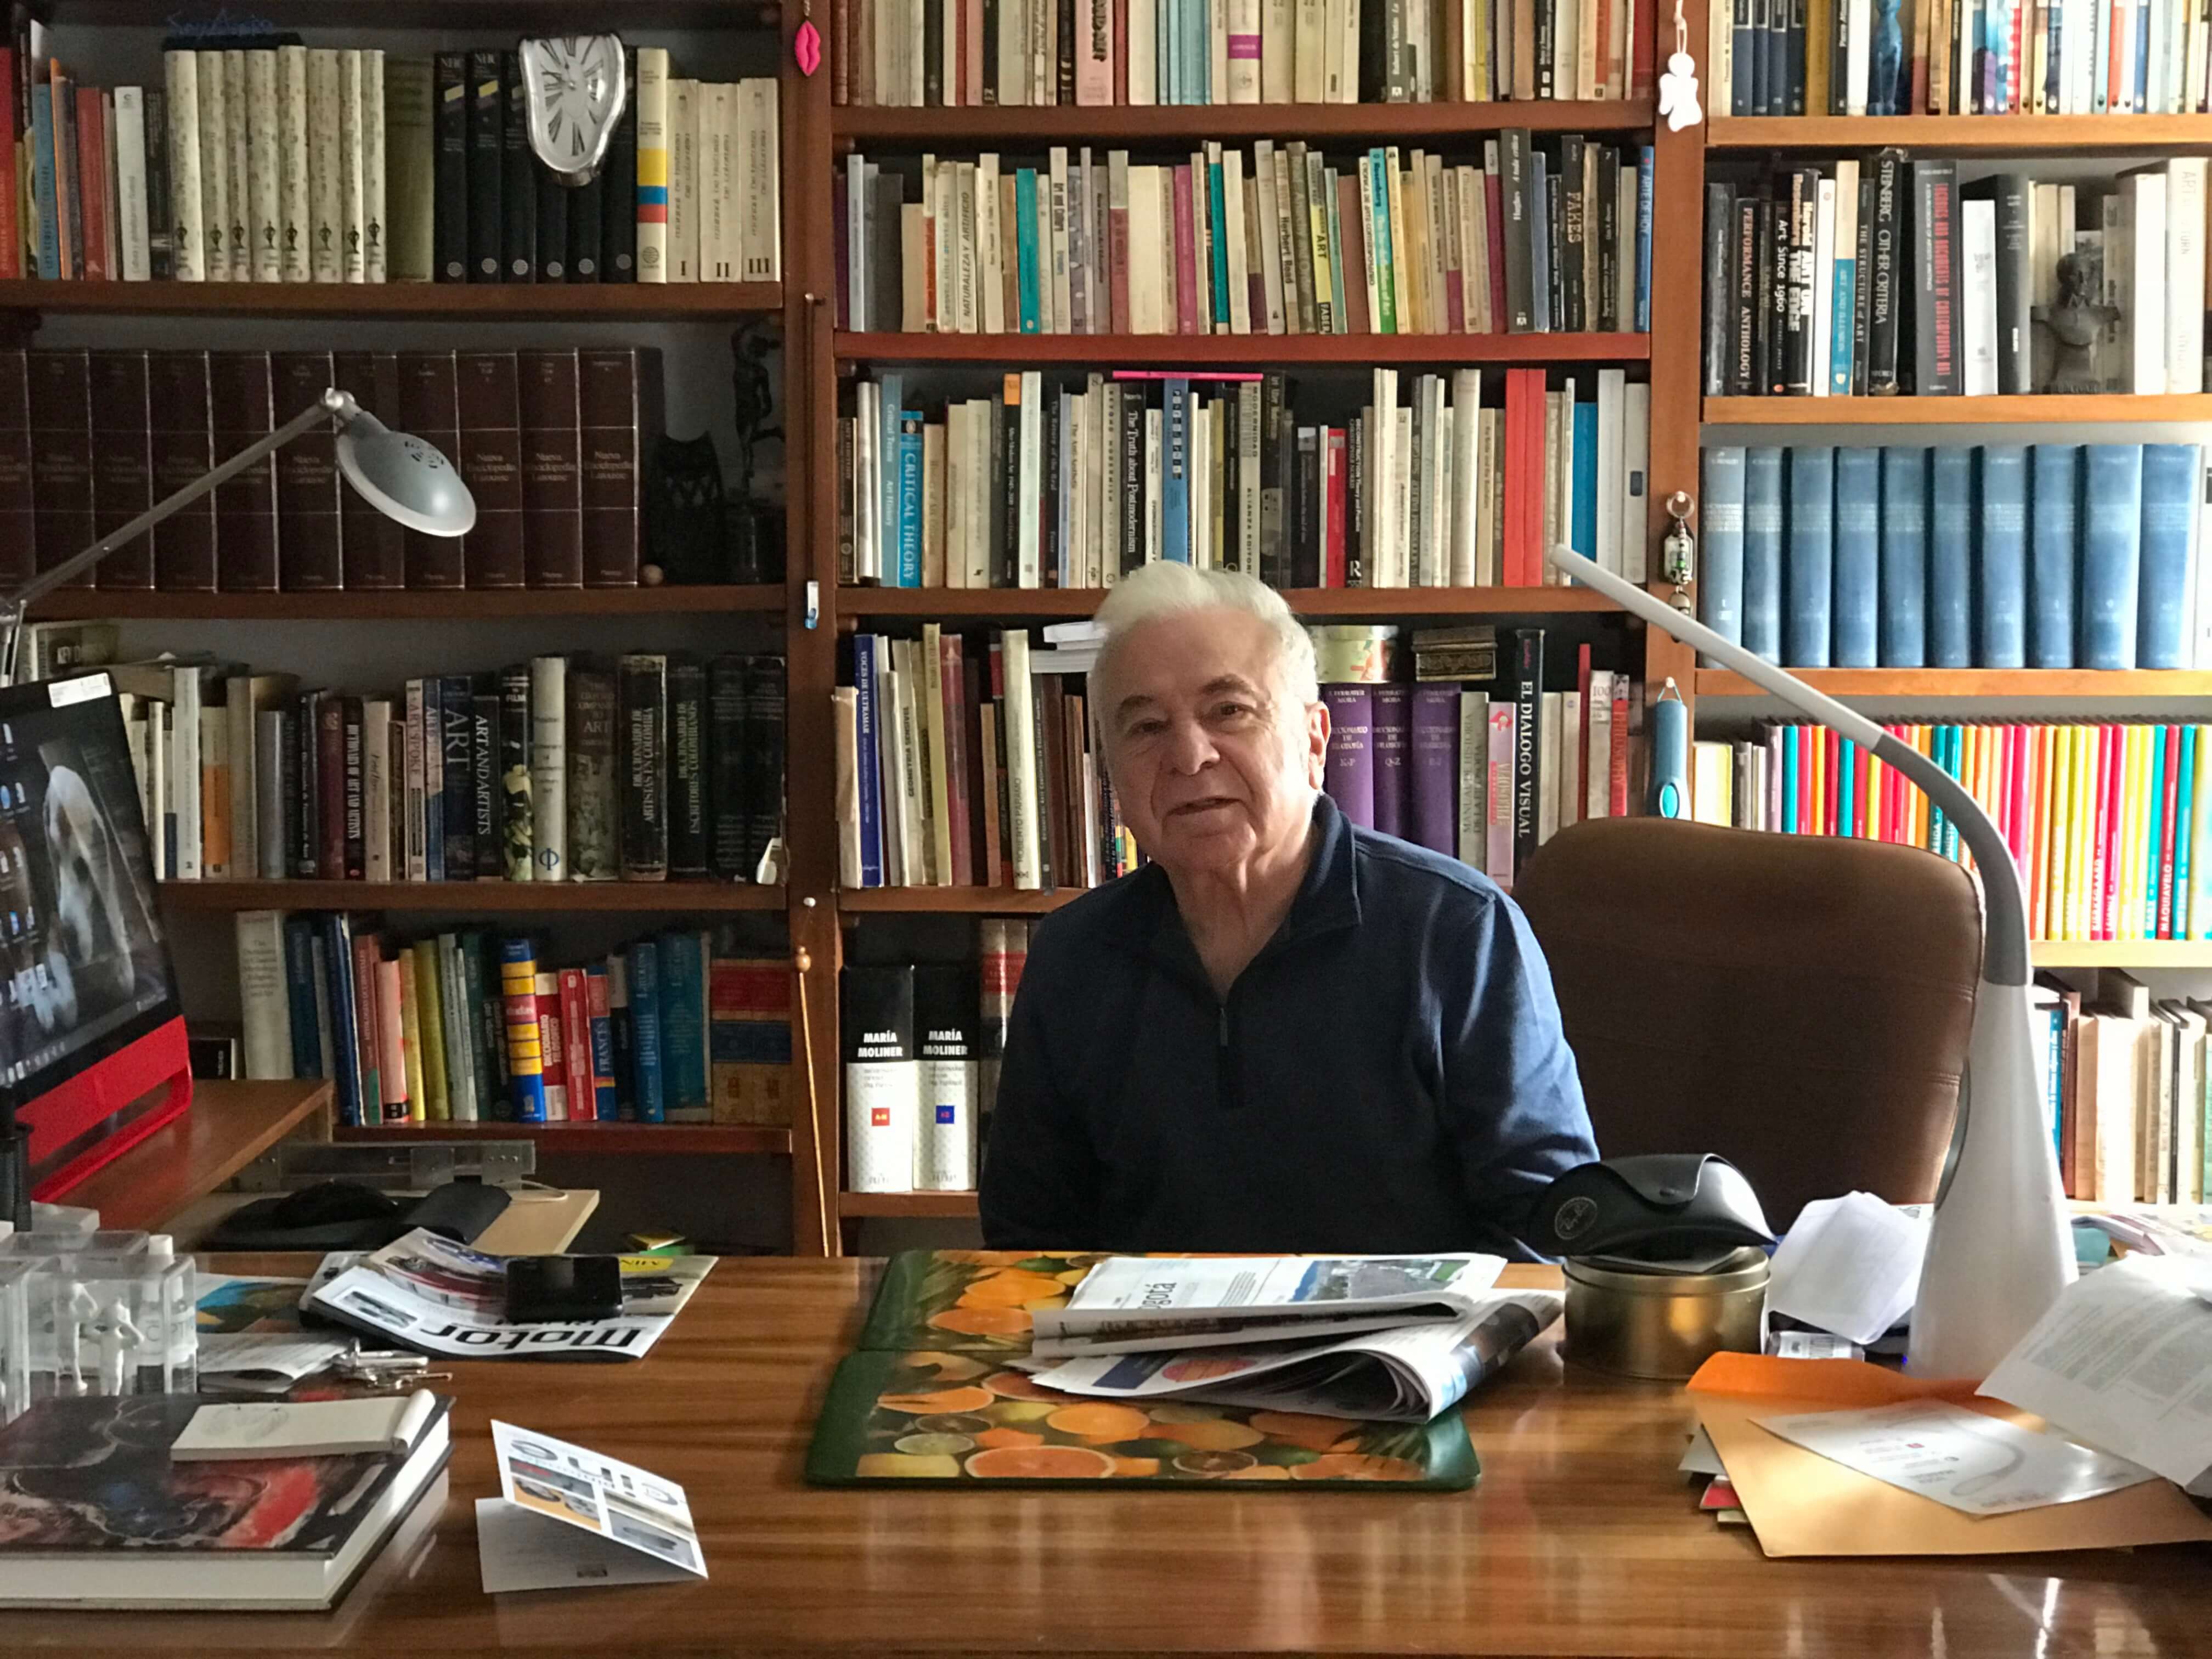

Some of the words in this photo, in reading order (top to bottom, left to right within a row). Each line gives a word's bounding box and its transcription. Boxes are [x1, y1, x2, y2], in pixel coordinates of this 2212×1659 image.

[1373, 162, 1384, 207] Rosenberg
[1640, 175, 1651, 199] ARTE
[1878, 160, 1894, 221] STEINBERG
[960, 191, 971, 242] ARTIFICIO
[1567, 191, 1582, 244] FAKES
[1639, 201, 1651, 214] DE
[1791, 173, 1803, 246] Rosenberg
[1280, 216, 1293, 256] Herbert
[1639, 215, 1651, 235] HOY
[1778, 220, 1788, 240] Art
[1801, 202, 1813, 246] Harold
[1859, 224, 1869, 244] THE
[1934, 222, 1949, 236] AND
[1316, 235, 1327, 259] ART
[1741, 207, 1753, 298] PERFORMANCE
[1877, 229, 1892, 270] OTHER
[748, 258, 769, 274] III
[1284, 259, 1294, 284] Read
[1778, 246, 1788, 279] Since
[1788, 250, 1802, 283] THE
[1801, 251, 1814, 285] ART
[961, 253, 972, 317] NATURALEZA
[1838, 269, 1848, 287] ART
[1857, 248, 1867, 308] STRUCTURE
[1936, 287, 1950, 297] OF
[1775, 284, 1787, 313] 1960
[1788, 287, 1802, 332] EDGE
[1801, 289, 1813, 316] ON
[1838, 291, 1848, 310] AND
[1874, 272, 1890, 324] CRITERIA
[1319, 303, 1331, 332] FABER
[1837, 312, 1847, 353] ILLUSION
[1739, 306, 1751, 380] ANTHOLOGY
[1855, 323, 1864, 343] ART
[1936, 362, 1951, 376] ART
[885, 403, 895, 434] Critical
[1049, 400, 1058, 415] The
[1127, 411, 1138, 427] The
[1049, 417, 1058, 443] Return
[1071, 423, 1079, 437] The
[1126, 430, 1138, 456] Truth
[885, 436, 895, 463] Terms
[1049, 447, 1058, 455] of
[1049, 458, 1058, 471] the
[1070, 440, 1079, 489] Anti-Aesthetic
[901, 452, 917, 517] CRITICAL
[1049, 474, 1058, 490] Real
[1127, 458, 1138, 482] about
[885, 480, 894, 493] Art
[884, 495, 894, 527] History
[1126, 483, 1139, 553] Postmodernism
[902, 523, 916, 580] THEORY
[860, 651, 869, 676] VOCES
[506, 693, 526, 702] FILM
[861, 678, 870, 689] DE
[1520, 680, 1533, 698] EL
[631, 709, 641, 724] DE
[676, 702, 687, 717] DE
[862, 691, 871, 734] ULTRAMAR
[444, 708, 471, 771] ART
[475, 714, 489, 745] ART
[583, 720, 611, 733] ART
[642, 707, 654, 758] COLOMBIA
[687, 701, 699, 769] COLOMBIANOS
[902, 707, 912, 746] SENSIVEL
[1463, 713, 1472, 764] HISTORIA
[1519, 702, 1533, 775] DIALOGO
[346, 724, 360, 765] DICTIONARY
[631, 725, 642, 787] DICCIONARIO
[677, 719, 688, 779] DICCIONARIO
[1613, 712, 1625, 785] PHILOSOPHY
[347, 767, 360, 775] OF
[476, 746, 490, 779] AND
[642, 760, 654, 774] EN
[907, 748, 915, 797] GEOMETRIA
[1340, 758, 1356, 767] K-P
[1385, 757, 1402, 768] Q-Z
[1464, 769, 1472, 782] DE
[347, 778, 360, 793] ART
[347, 794, 360, 807] AND
[642, 775, 654, 823] ARTISTAS
[476, 780, 491, 835] ARTISTS
[689, 772, 700, 834] ESCRITORES
[1463, 788, 1472, 833] MANUAL
[1517, 780, 1532, 838] VISUAL
[347, 809, 360, 839] ARTISTS
[1014, 818, 1024, 863] ROBERTO
[2159, 864, 2172, 932] MAQUIAVELO
[540, 1014, 552, 1067] DICCIONARIO
[595, 1020, 610, 1071] FRANCÉS
[863, 1030, 898, 1043] MARÍA
[928, 1028, 962, 1041] MARÍA
[857, 1046, 903, 1058] MOLINER
[922, 1045, 968, 1056] MOLINER
[420, 1325, 641, 1351] motor
